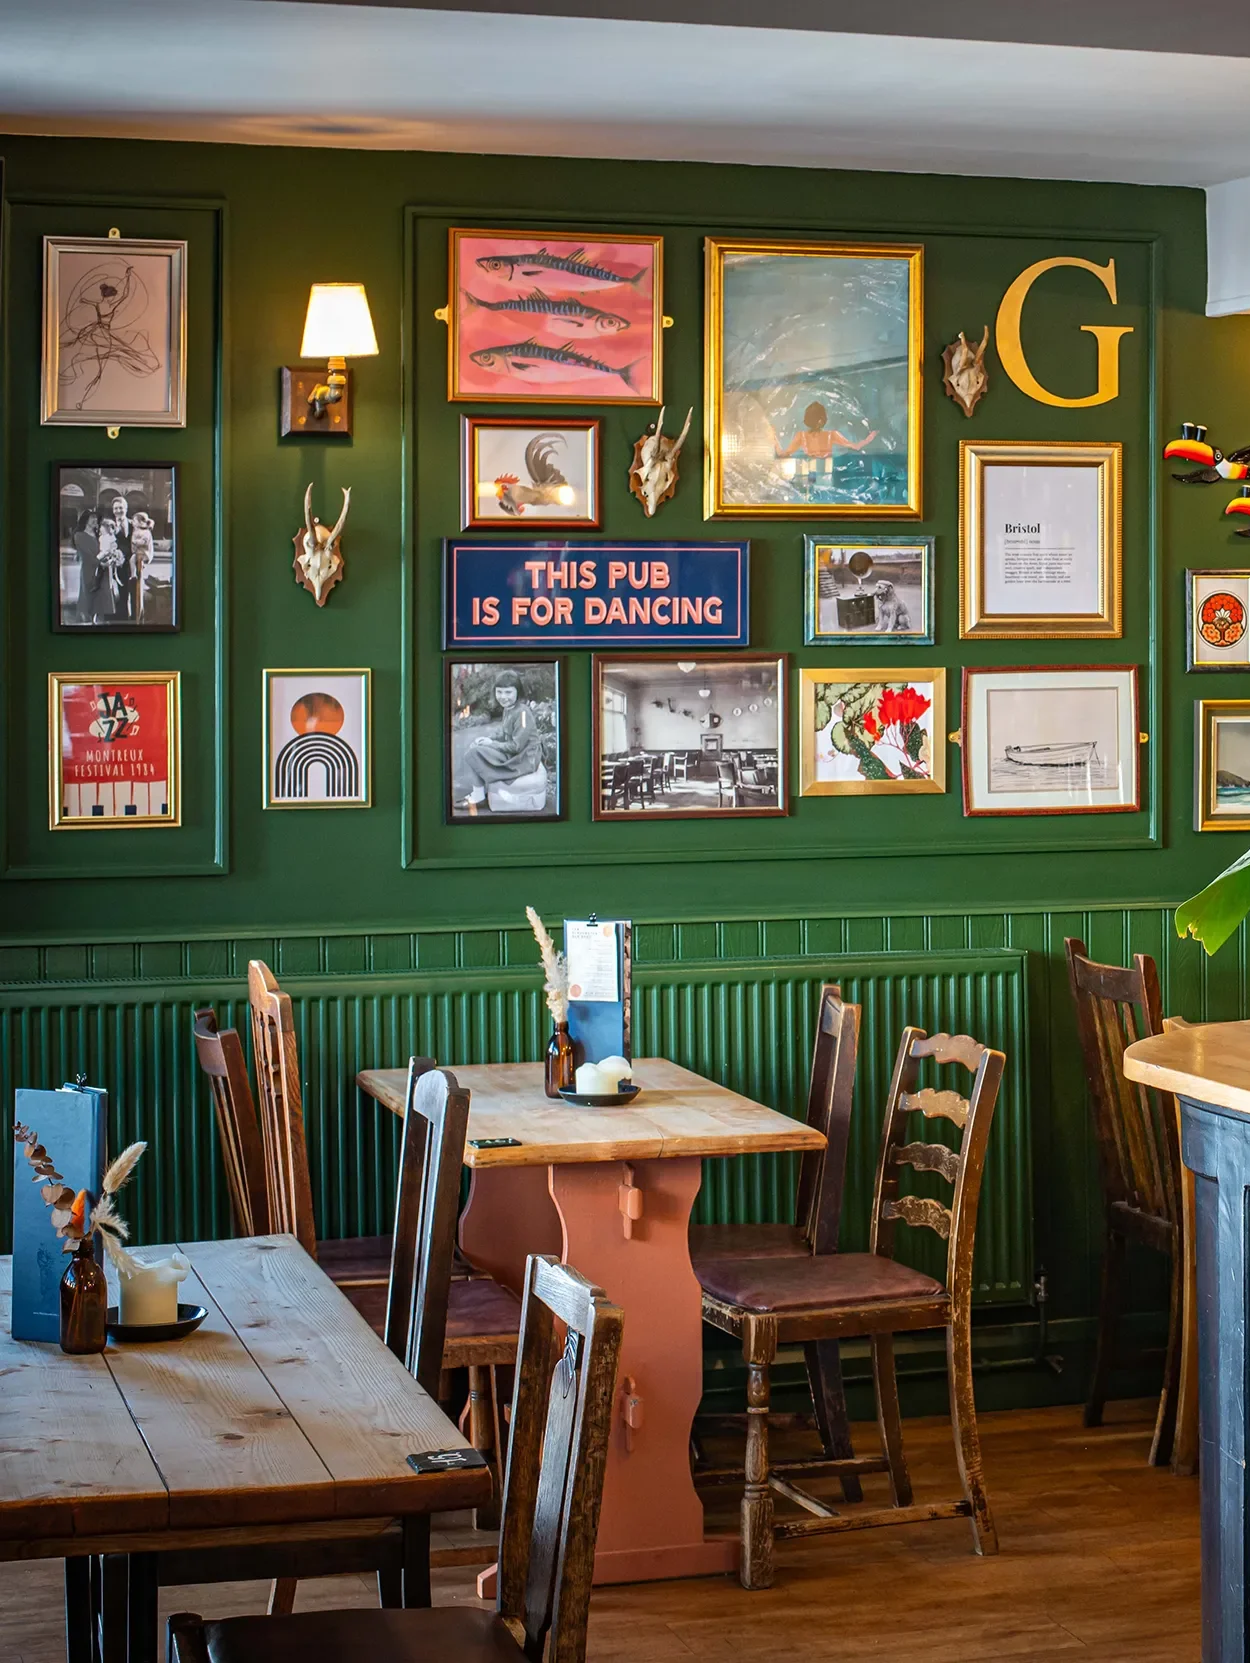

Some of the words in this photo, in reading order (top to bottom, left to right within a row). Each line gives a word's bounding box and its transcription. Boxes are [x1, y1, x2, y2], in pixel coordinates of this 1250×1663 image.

[996, 256, 1135, 408] G
[1004, 523, 1041, 534] Bristol
[525, 560, 597, 590] THIS
[608, 561, 671, 590] PUB
[472, 596, 501, 627] IS
[512, 596, 574, 627] FOR
[584, 595, 724, 627] DANCING
[86, 749, 144, 763] MONTREUX
[74, 763, 124, 778] FESTIVAL
[131, 763, 156, 777] 1984
